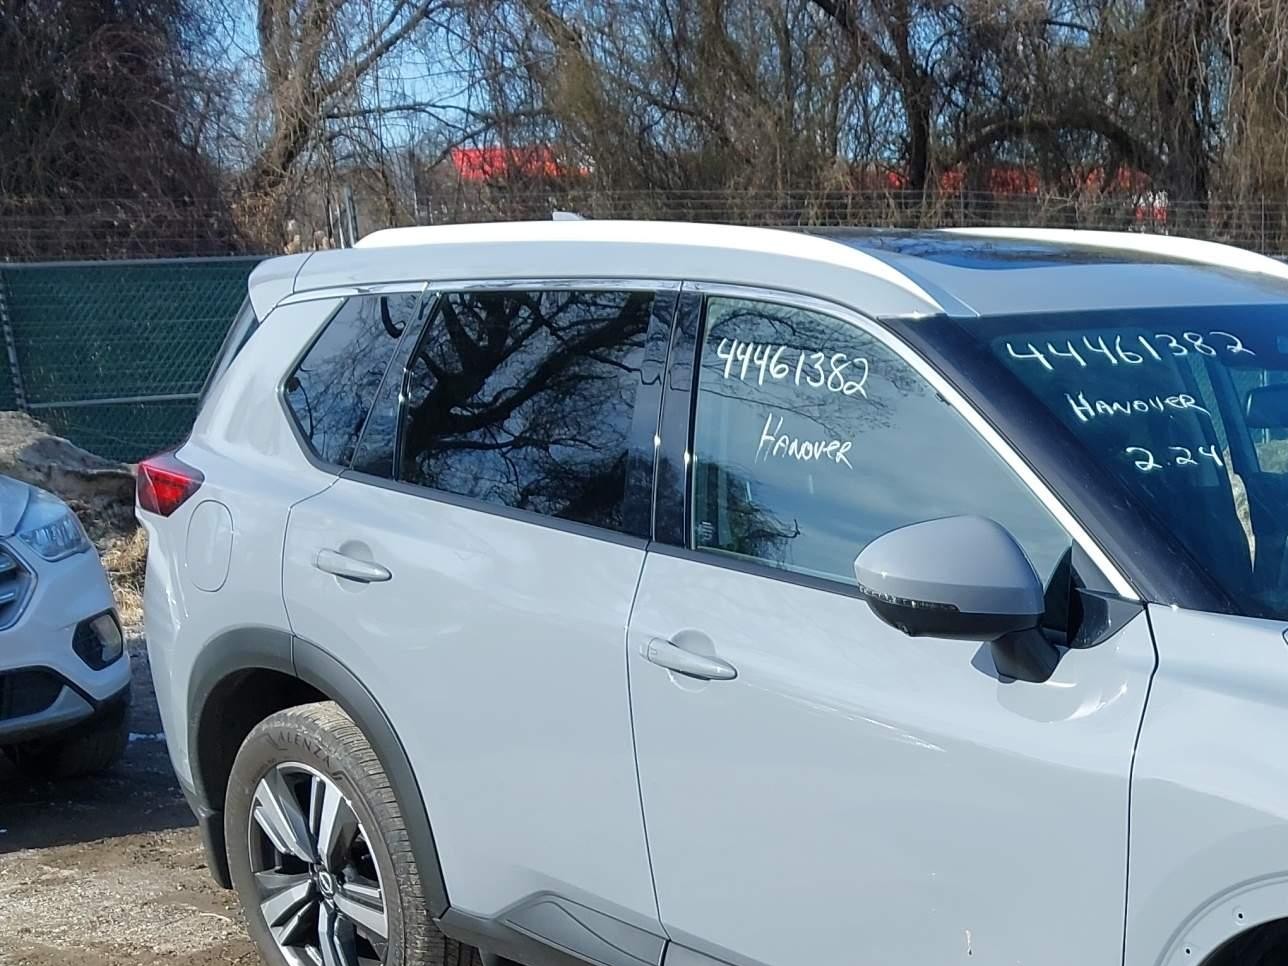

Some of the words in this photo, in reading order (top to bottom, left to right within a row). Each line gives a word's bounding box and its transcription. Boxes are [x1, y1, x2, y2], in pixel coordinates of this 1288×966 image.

[716, 337, 868, 399] 44461382
[1006, 331, 1255, 371] 44461382
[1125, 444, 1224, 472] 2.24
